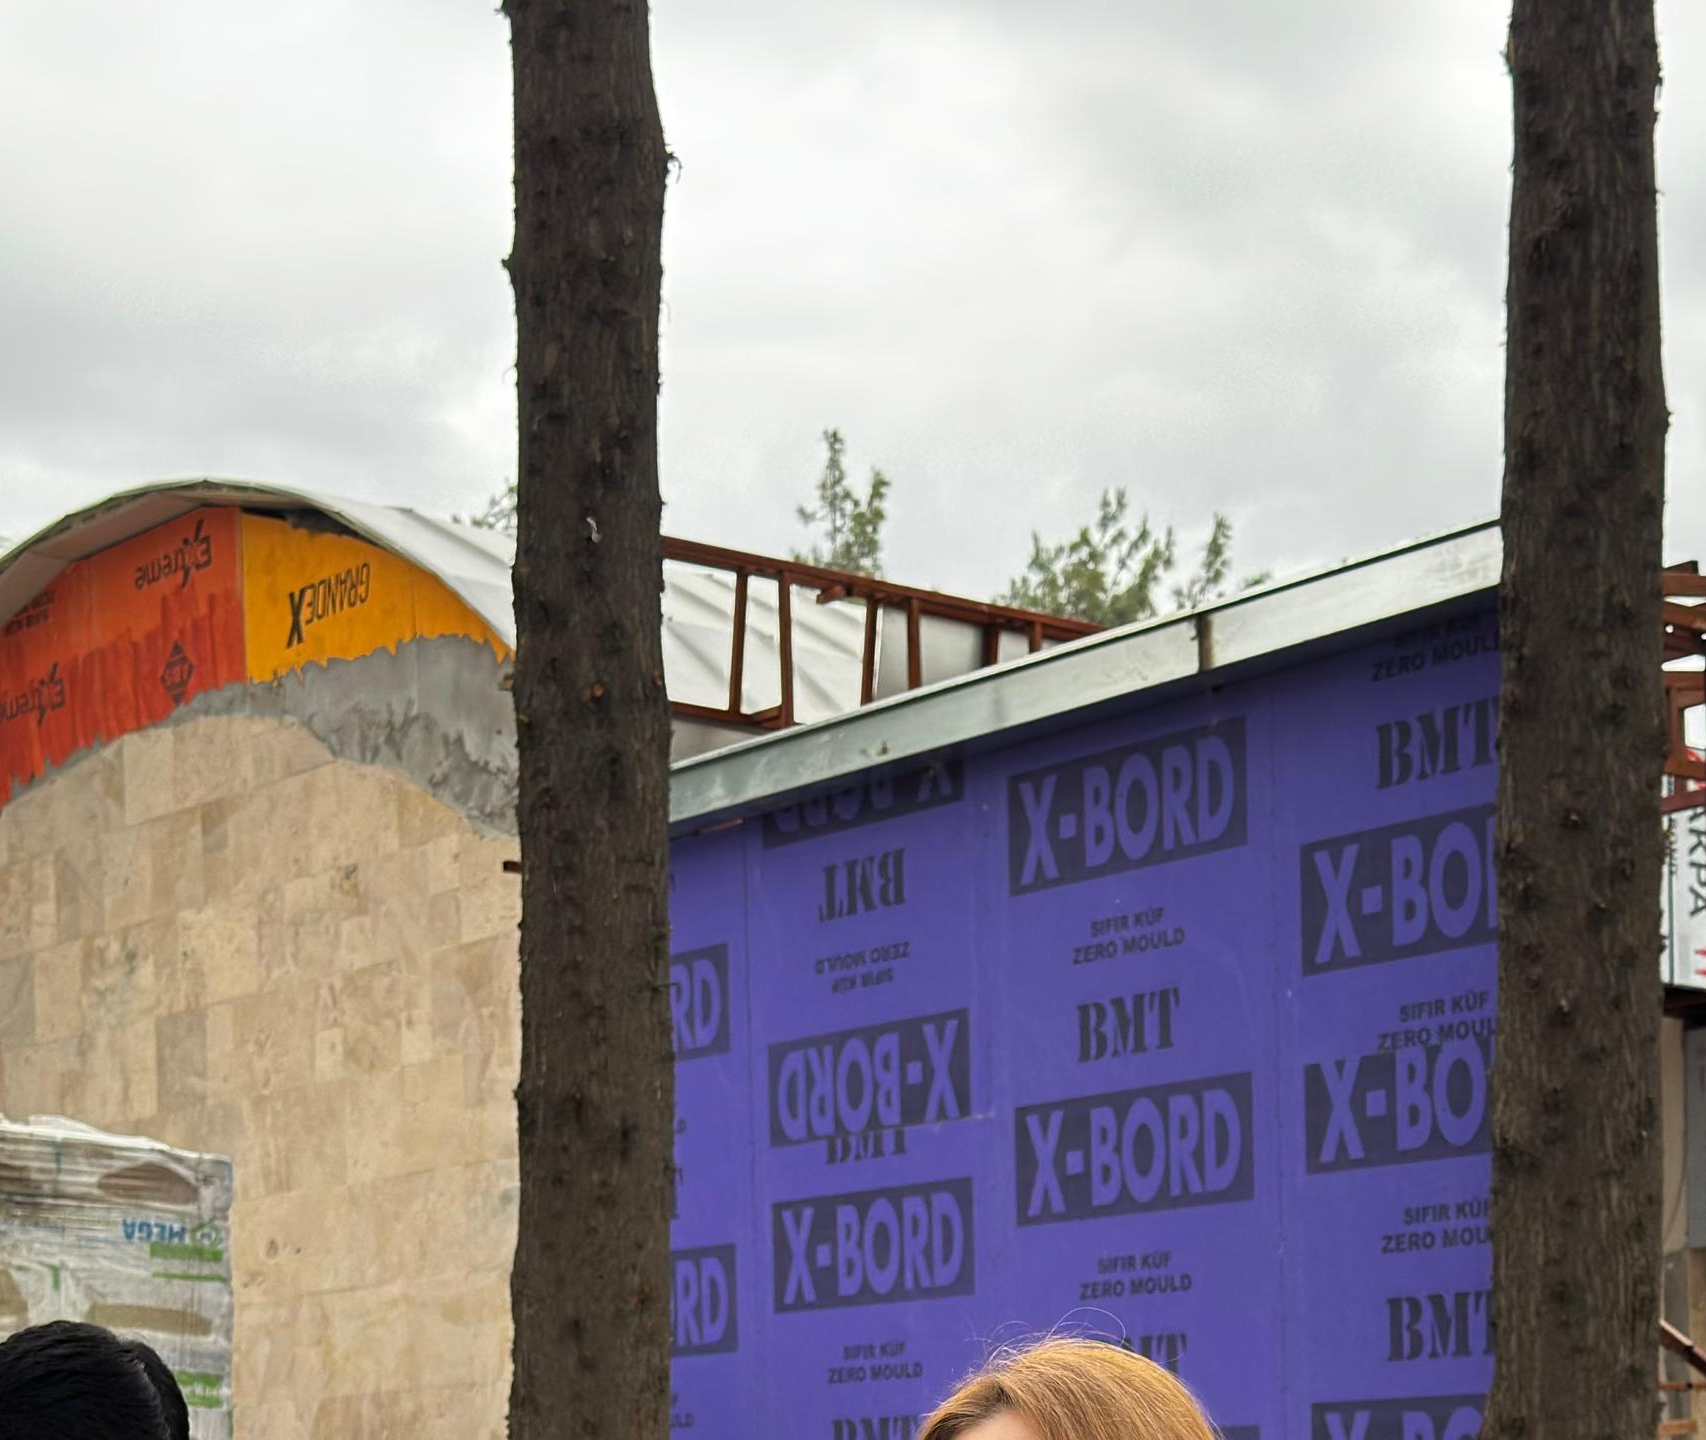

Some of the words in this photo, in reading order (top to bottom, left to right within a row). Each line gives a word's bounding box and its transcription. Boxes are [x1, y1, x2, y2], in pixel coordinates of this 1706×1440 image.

[286, 562, 371, 648] GRANDEX
[1376, 697, 1499, 790] BMT
[1019, 735, 1233, 886] X-BORD
[819, 848, 906, 922] BMT
[1314, 818, 1497, 965] X-BO
[1072, 941, 1118, 964] ZERO
[1123, 927, 1185, 957] MOULD
[1077, 987, 1181, 1063] BMT
[1378, 1029, 1431, 1053] ZERO
[1399, 999, 1445, 1022] SIFIR
[1451, 990, 1489, 1013] KÜF
[777, 1018, 960, 1142] X-BORD
[1319, 1038, 1486, 1164] X-BO
[1025, 1088, 1242, 1217] X-BORD
[121, 1217, 186, 1244] MEGA
[782, 1193, 964, 1304] X-BORD
[1381, 1233, 1435, 1254] ZERO
[1441, 1225, 1495, 1248] MOU
[1404, 1203, 1450, 1226] SIFIR
[1079, 1279, 1125, 1300] ZERO
[1130, 1273, 1192, 1295] MOULD
[828, 1366, 866, 1384] ZERO
[871, 1362, 923, 1380] MOULD
